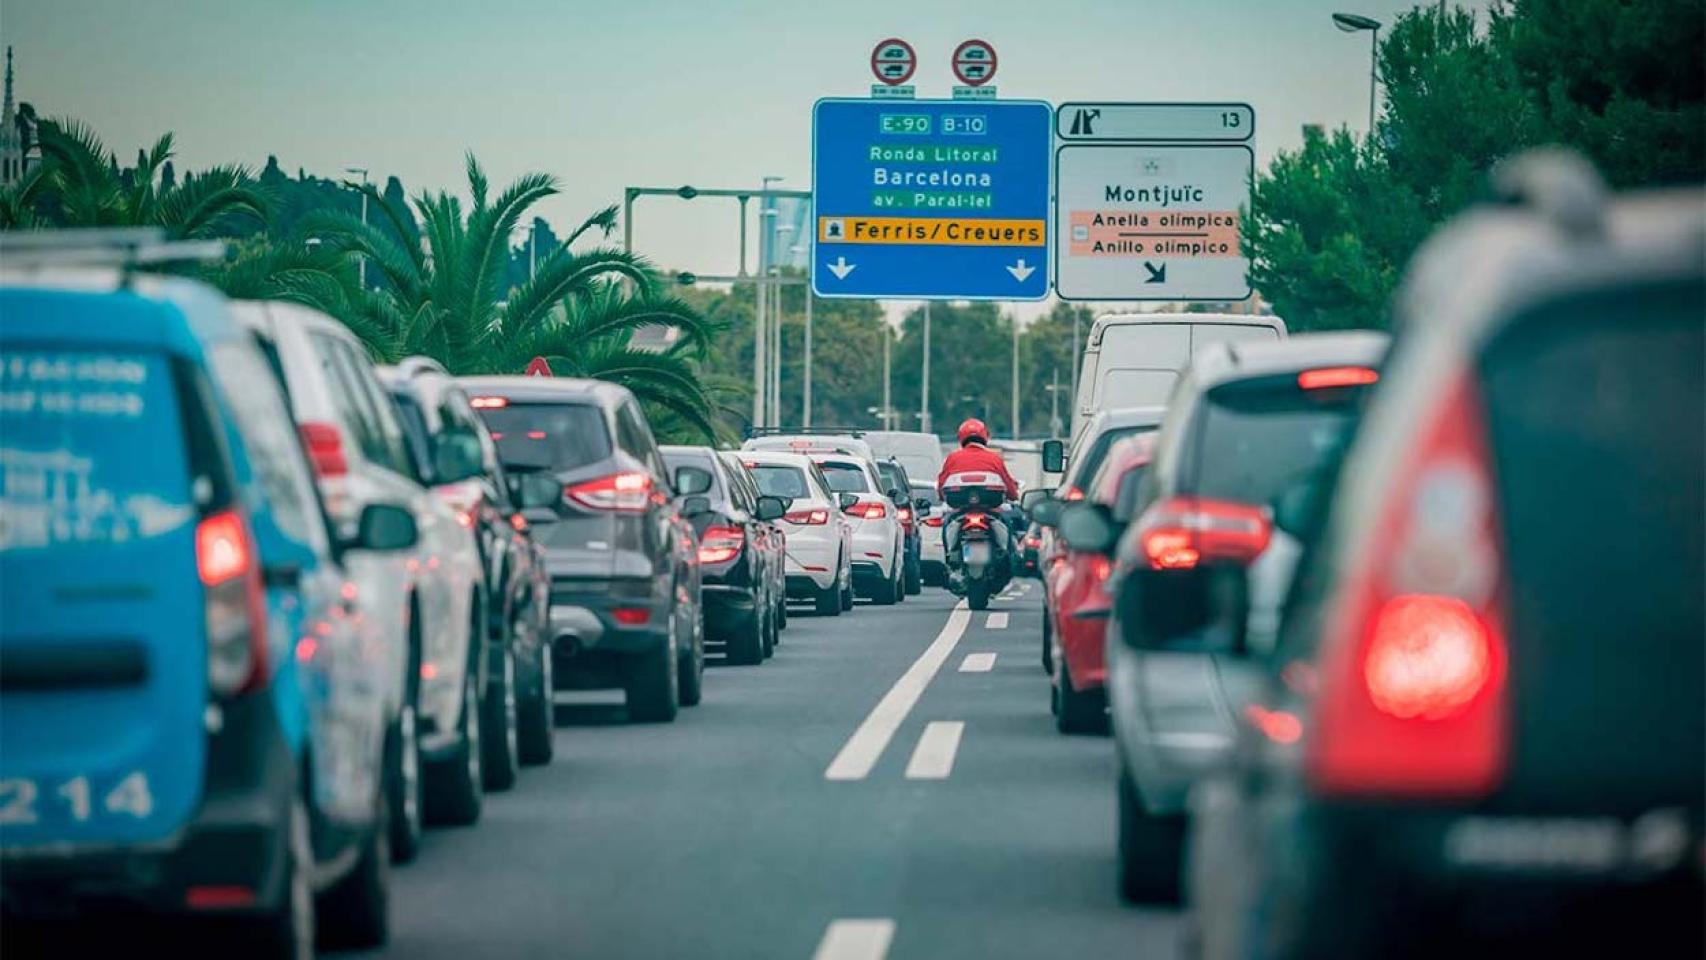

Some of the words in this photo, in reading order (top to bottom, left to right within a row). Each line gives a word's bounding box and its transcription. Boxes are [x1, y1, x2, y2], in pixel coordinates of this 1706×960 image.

[883, 117, 929, 132] E-90
[943, 118, 984, 132] B-10
[1221, 112, 1240, 128] 13
[870, 146, 925, 161] Ronda
[935, 147, 997, 162] Litoral
[873, 167, 991, 186] Barcelona
[873, 194, 903, 207] av.
[1105, 185, 1204, 207] Montjuïc
[1092, 213, 1149, 226] Anella
[1159, 213, 1234, 229] olímpica
[854, 221, 1040, 242] Ferris/Creuers
[1092, 240, 1144, 254] Anillo
[1154, 240, 1229, 256] olímpico
